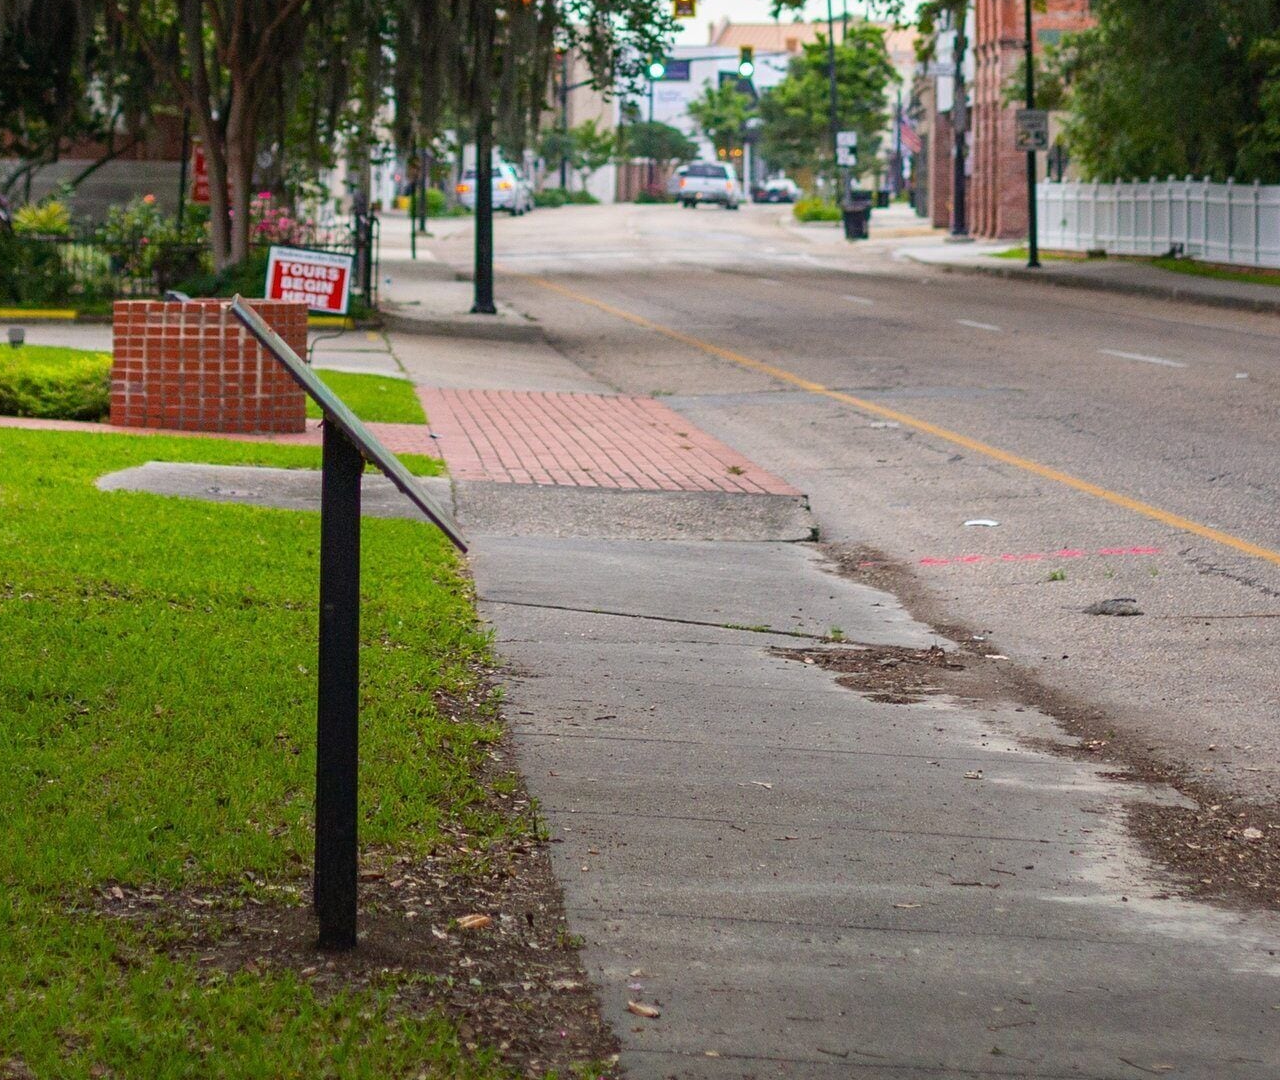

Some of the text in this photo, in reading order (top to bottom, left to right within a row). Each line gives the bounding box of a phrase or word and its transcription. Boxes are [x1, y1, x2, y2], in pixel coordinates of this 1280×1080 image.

[280, 261, 340, 282] TOURS
[281, 276, 335, 296] BEGIN
[281, 290, 329, 308] HERE
